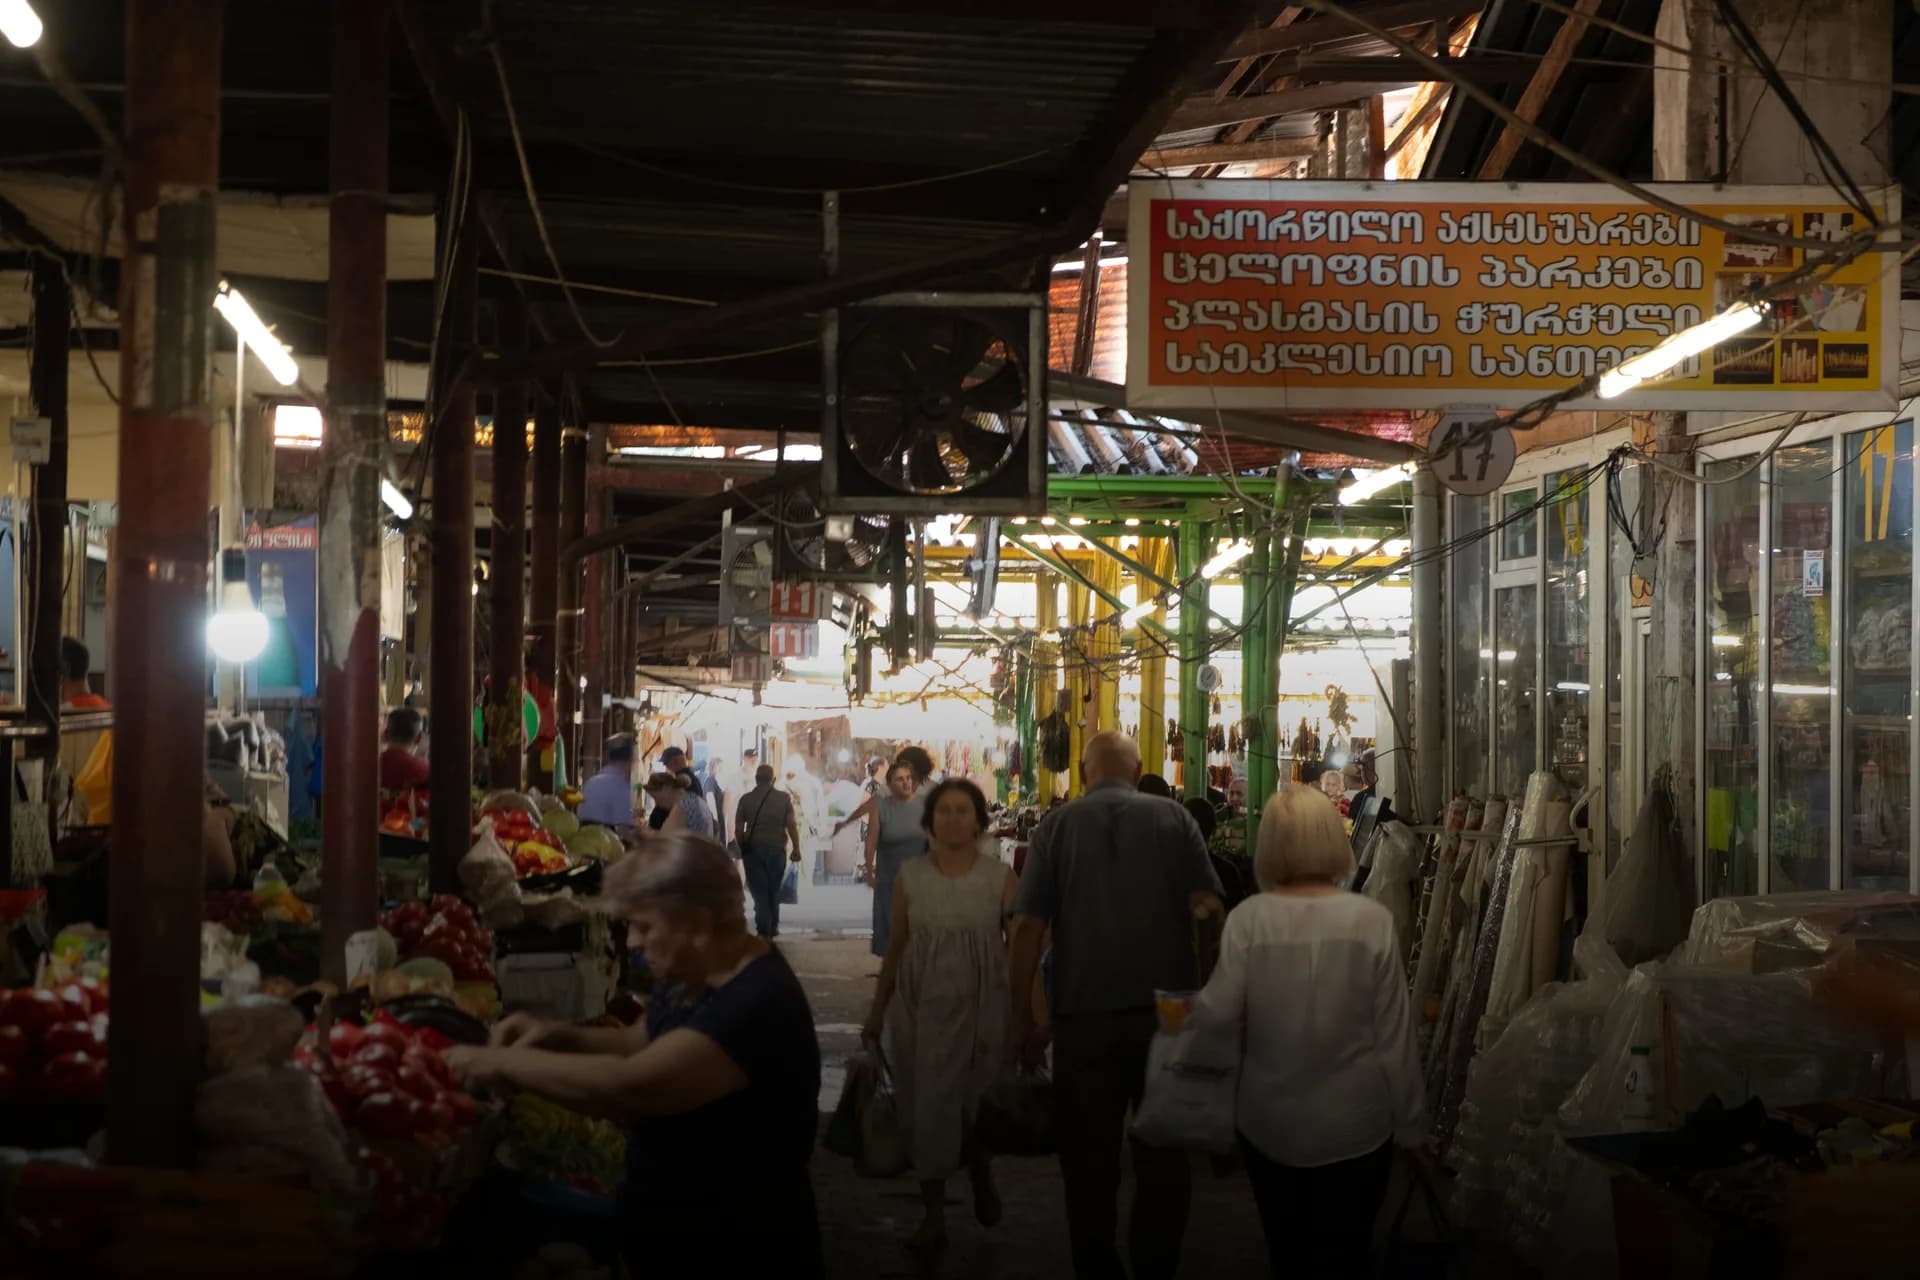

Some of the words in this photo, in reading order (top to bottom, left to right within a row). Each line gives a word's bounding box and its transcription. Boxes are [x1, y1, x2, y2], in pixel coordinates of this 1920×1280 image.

[1166, 208, 1424, 243] საქორწილო
[1437, 212, 1702, 246] აქსესუარები
[1163, 252, 1460, 287] ცელოფნის
[1479, 255, 1703, 289] პარკები
[1163, 299, 1440, 334] პლასმასის
[1456, 302, 1701, 335] ჭურჭელი
[1165, 341, 1452, 377] საეკლესიო
[1469, 343, 1700, 378] სანთეი
[1444, 422, 1495, 481] 17
[1860, 423, 1895, 541] 17
[776, 581, 811, 613] 11
